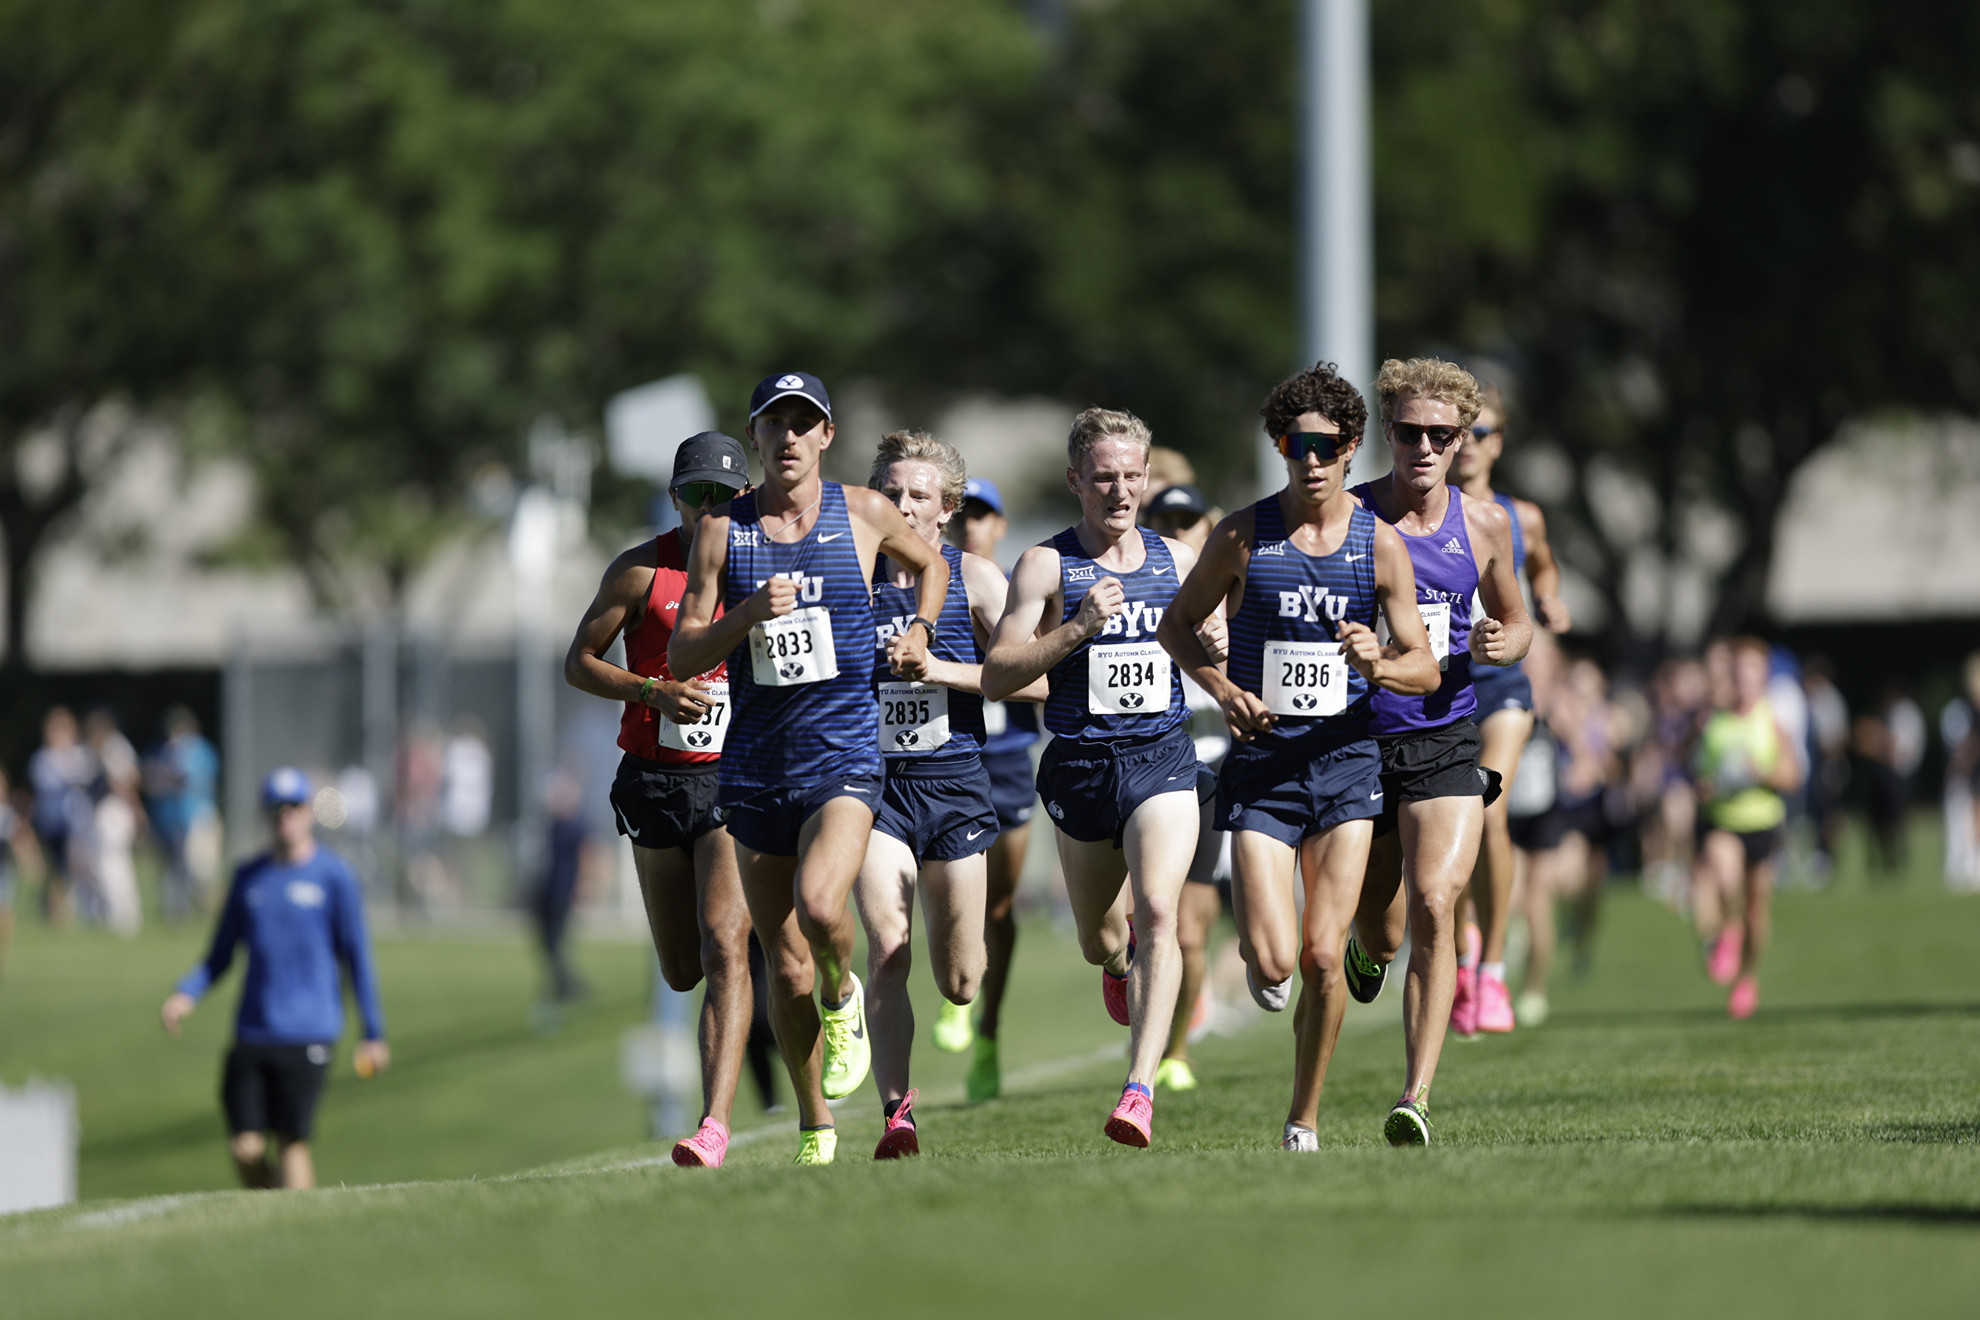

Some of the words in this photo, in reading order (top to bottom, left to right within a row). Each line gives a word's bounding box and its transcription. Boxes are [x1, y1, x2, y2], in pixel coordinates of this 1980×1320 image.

[1279, 585, 1349, 622] BYU
[1424, 588, 1463, 604] STATE
[1102, 601, 1163, 637] BYU
[765, 630, 813, 659] 2833
[1108, 661, 1154, 688] 2834
[1281, 662, 1330, 688] 2836
[884, 700, 930, 725] 2835
